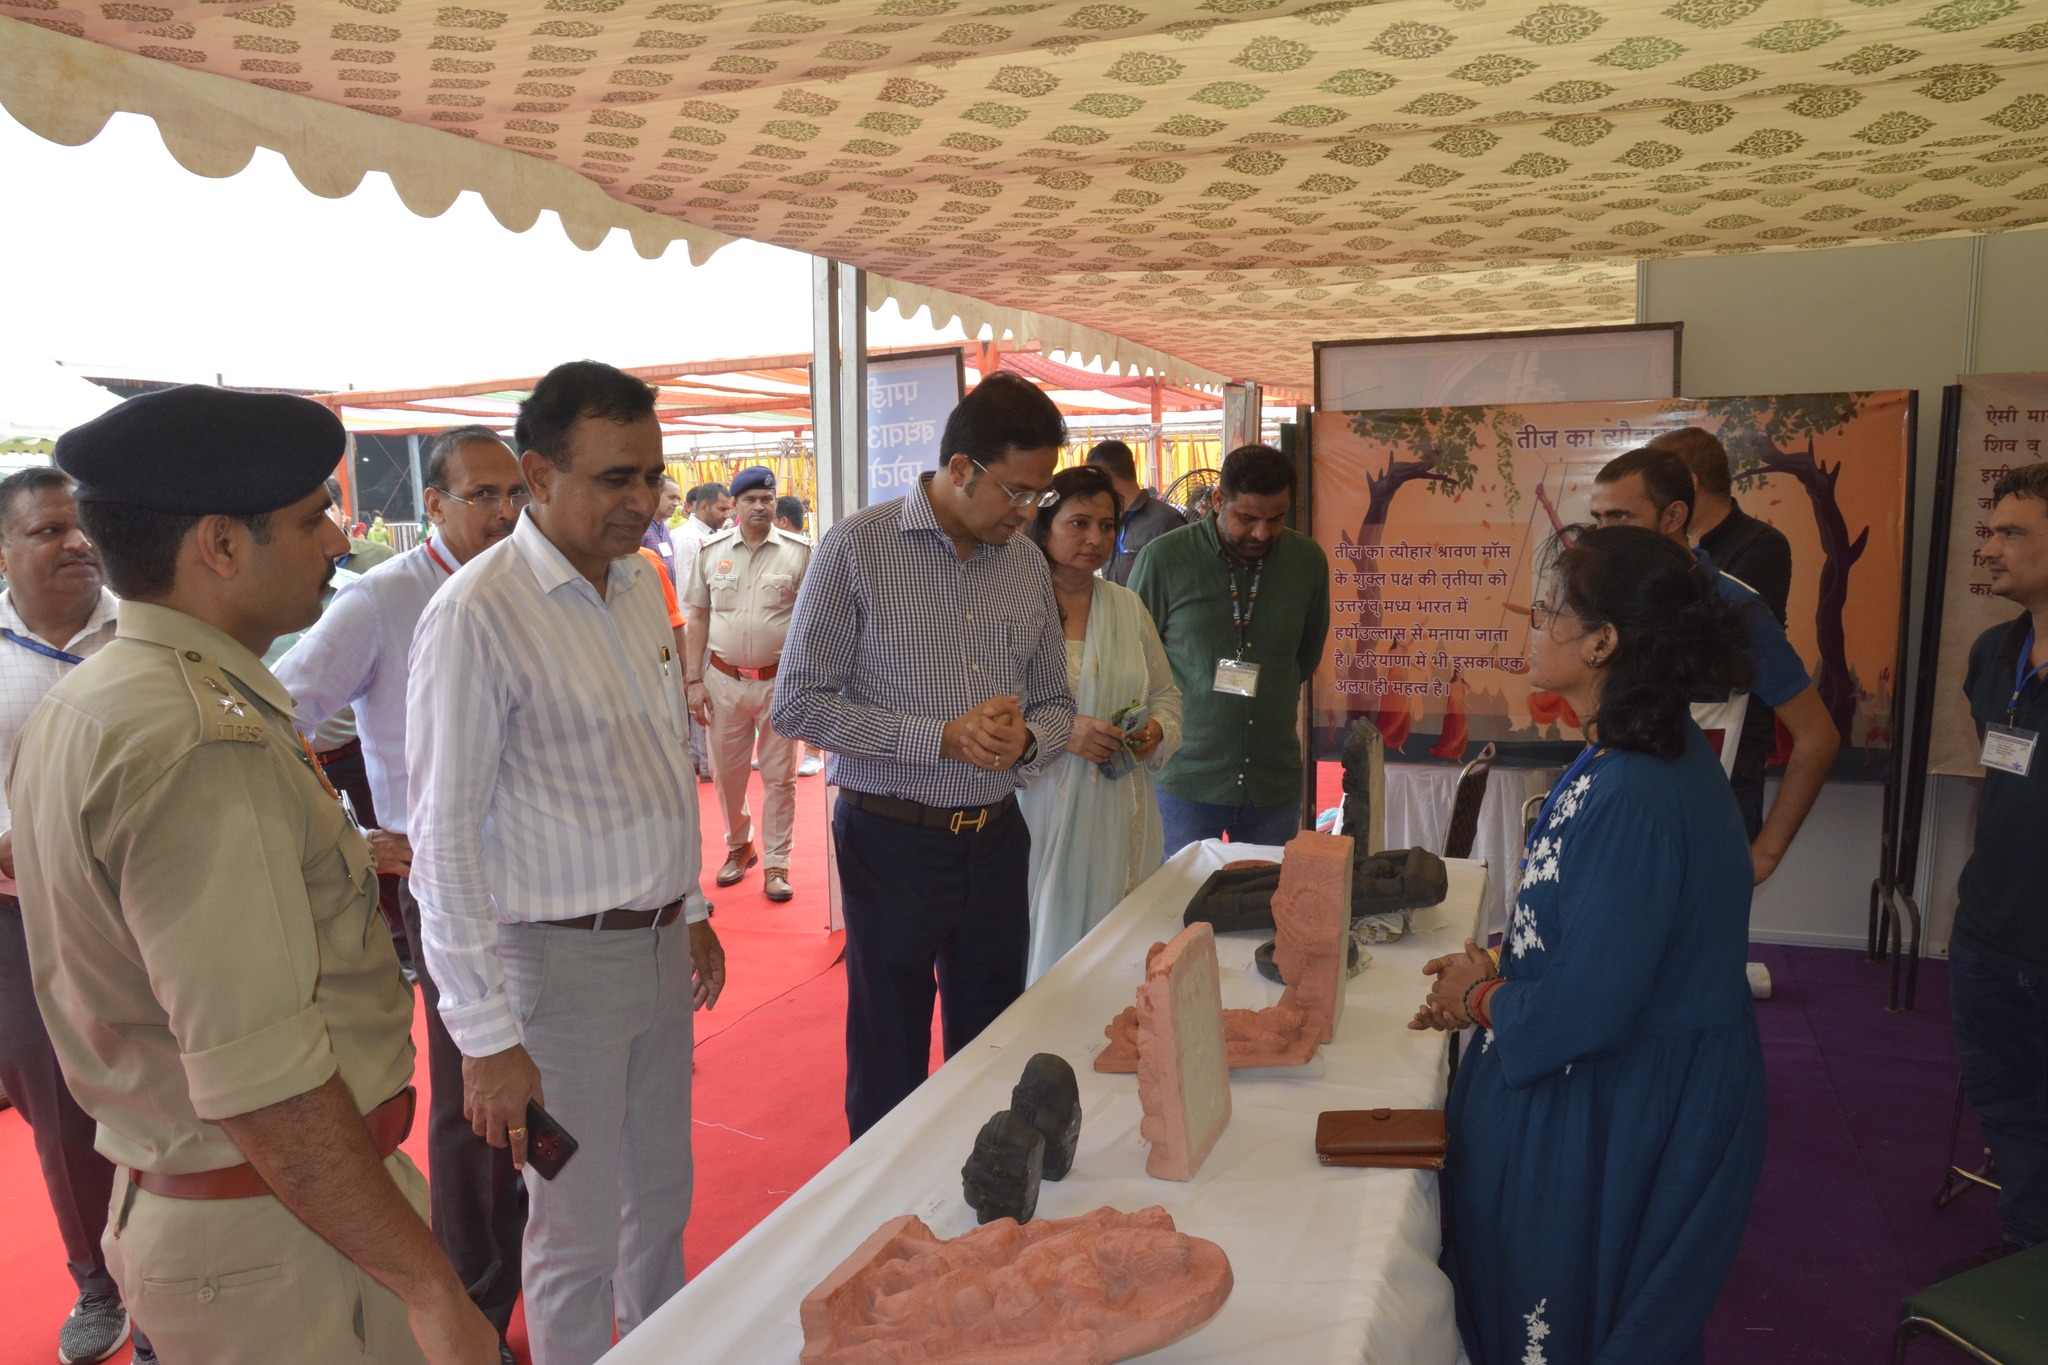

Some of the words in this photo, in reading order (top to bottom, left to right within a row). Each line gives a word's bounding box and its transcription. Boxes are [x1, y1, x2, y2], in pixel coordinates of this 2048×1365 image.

[1985, 405, 2019, 427] ऐसी
[1515, 423, 1559, 449] तीज
[1564, 428, 1595, 448] का
[1983, 433, 2018, 454] शिव
[1333, 541, 1361, 558] तीज
[1365, 546, 1385, 558] का
[1388, 540, 1433, 560] त्यौहार
[1437, 545, 1477, 558] श्रावण
[1481, 541, 1511, 558] मॉस
[1333, 568, 1348, 586] के
[1352, 573, 1386, 590] शुक्ल
[1390, 573, 1413, 587] पक्ष
[1417, 569, 1437, 586] की
[1441, 569, 1483, 590] तृतीया
[1487, 568, 1507, 586] को
[1333, 600, 1365, 613] उत्तर
[1382, 600, 1411, 613] मध्य
[1415, 600, 1452, 613] भारत
[1456, 597, 1469, 614] में
[1410, 624, 1423, 640] से
[1427, 628, 1470, 641] मनाया
[1475, 629, 1508, 642] जाता
[34, 644, 57, 656] POLICE
[1355, 651, 1411, 668] हरियाणा
[1415, 651, 1428, 668] में
[1431, 651, 1449, 668] भी
[1452, 656, 1495, 671] इसका
[1499, 657, 1525, 671] एक
[1334, 679, 1370, 694] अलग
[1374, 678, 1388, 695] ही
[1393, 681, 1429, 696] महत्व
